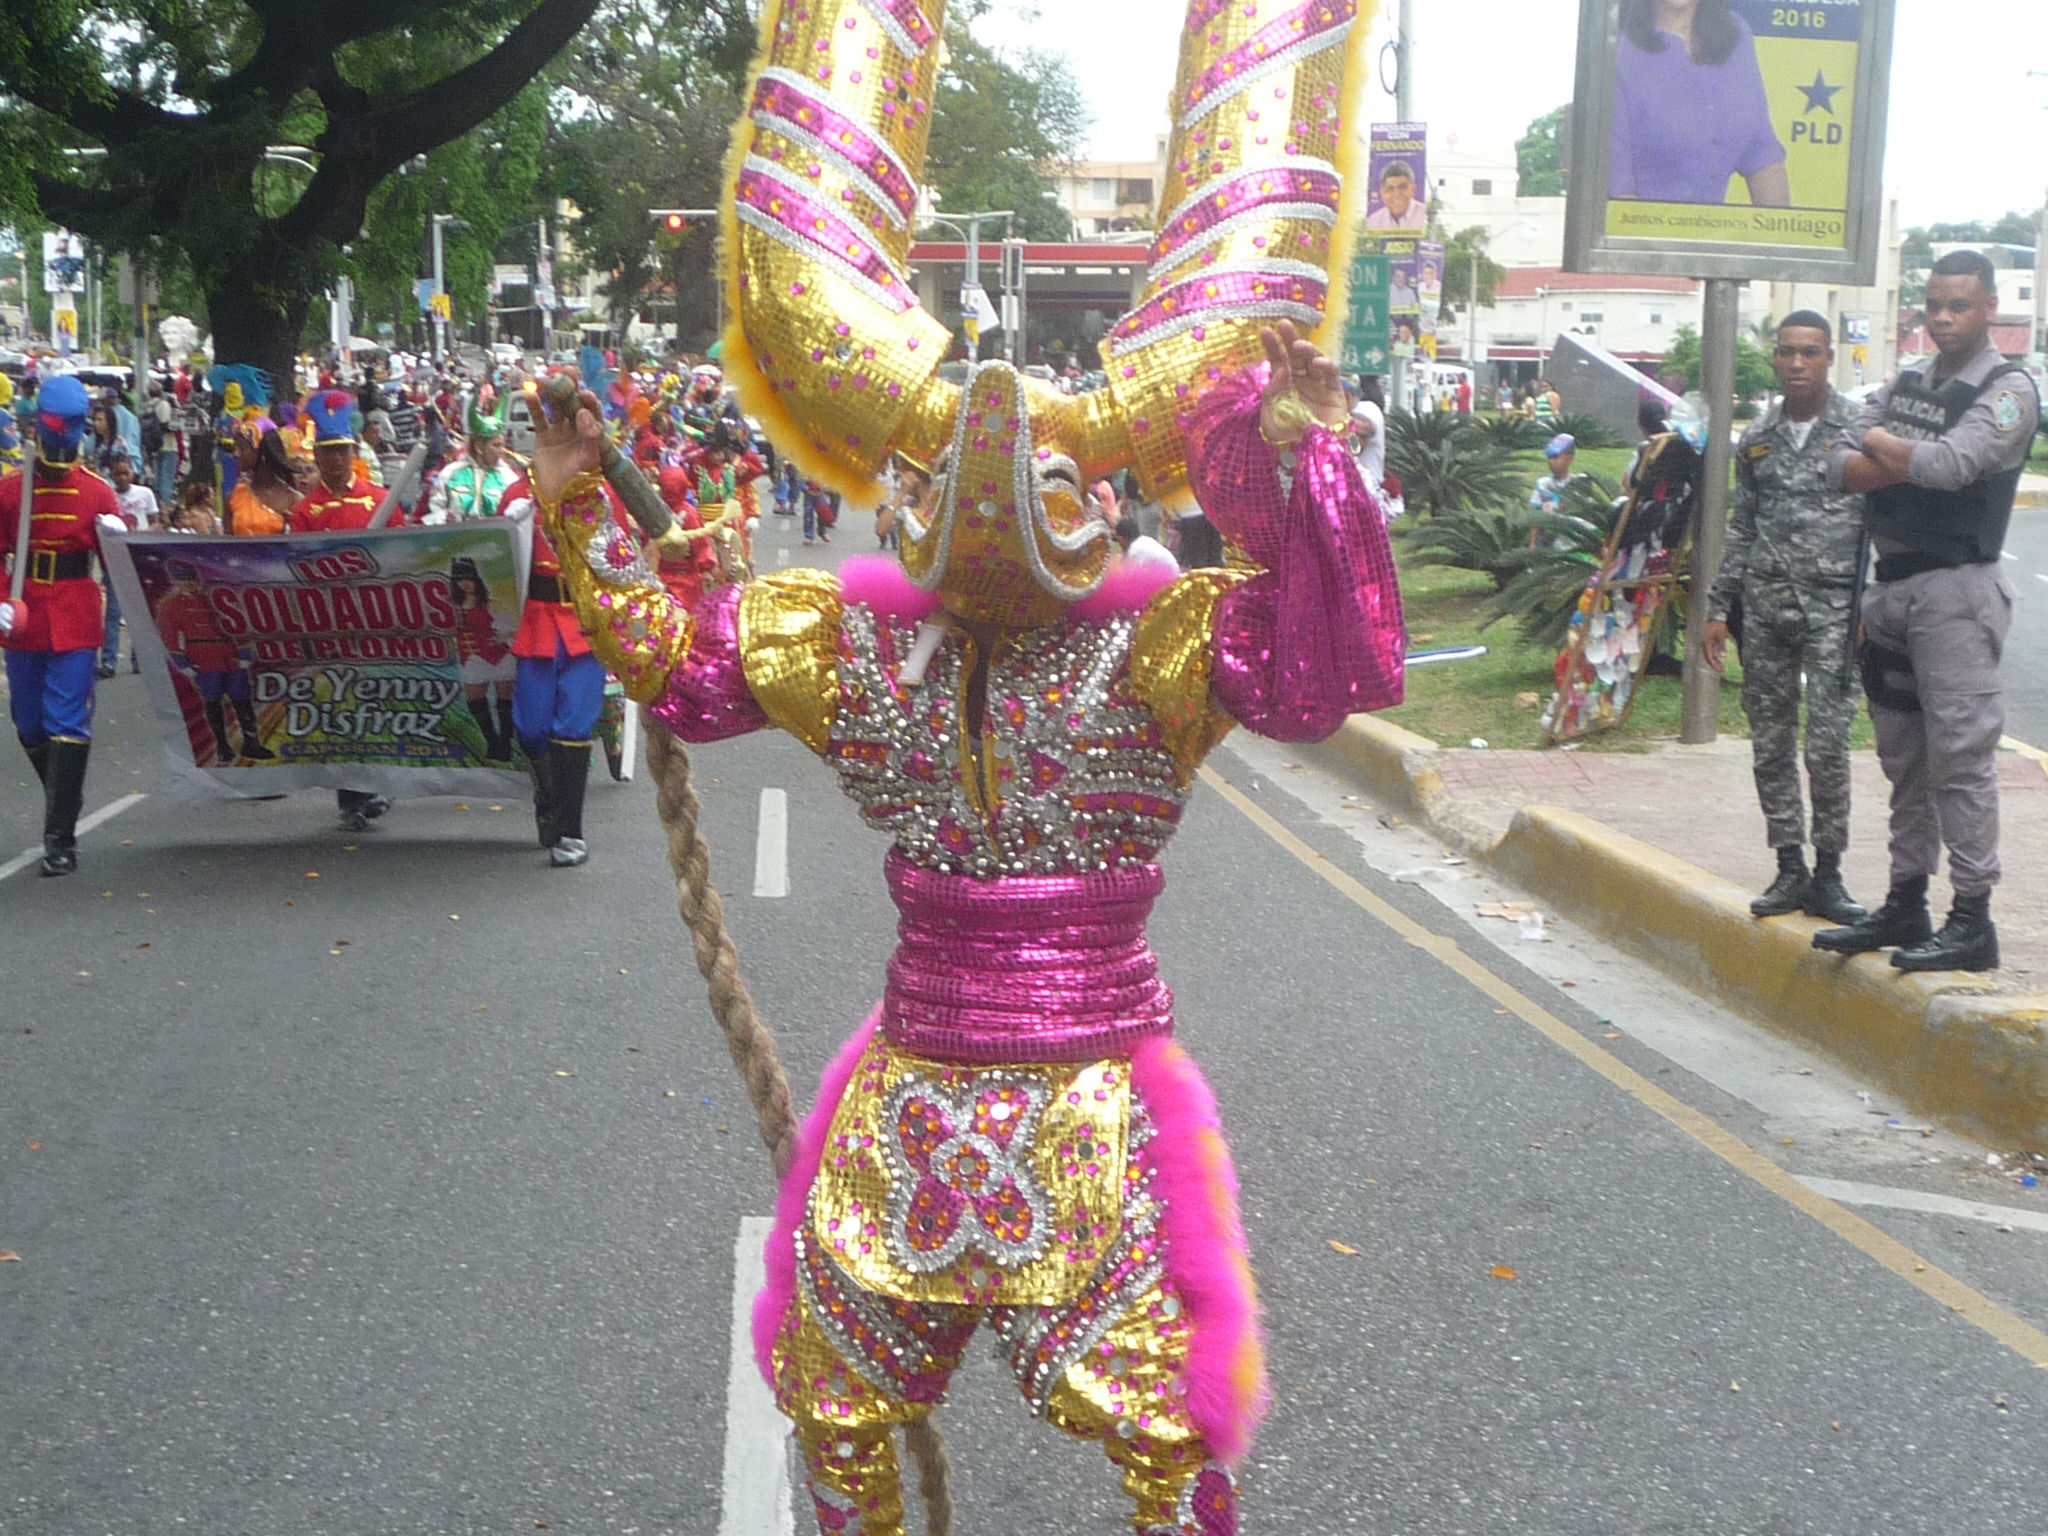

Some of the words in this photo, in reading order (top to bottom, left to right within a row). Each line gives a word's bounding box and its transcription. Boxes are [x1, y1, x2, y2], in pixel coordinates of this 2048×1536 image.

[1772, 8, 1826, 28] 2016
[1791, 120, 1843, 144] PLD
[1620, 211, 1664, 225] Juntos
[1668, 212, 1748, 230] cambiemos
[1752, 213, 1842, 238] Santiago
[1890, 395, 1946, 424] POLICIA
[298, 550, 369, 583] LOS
[211, 579, 456, 635] SOLDADOS
[255, 639, 305, 661] DE
[313, 636, 448, 660] PLOMO
[256, 672, 313, 701] De
[325, 668, 460, 710] Yenny
[287, 702, 447, 743] Disfraz
